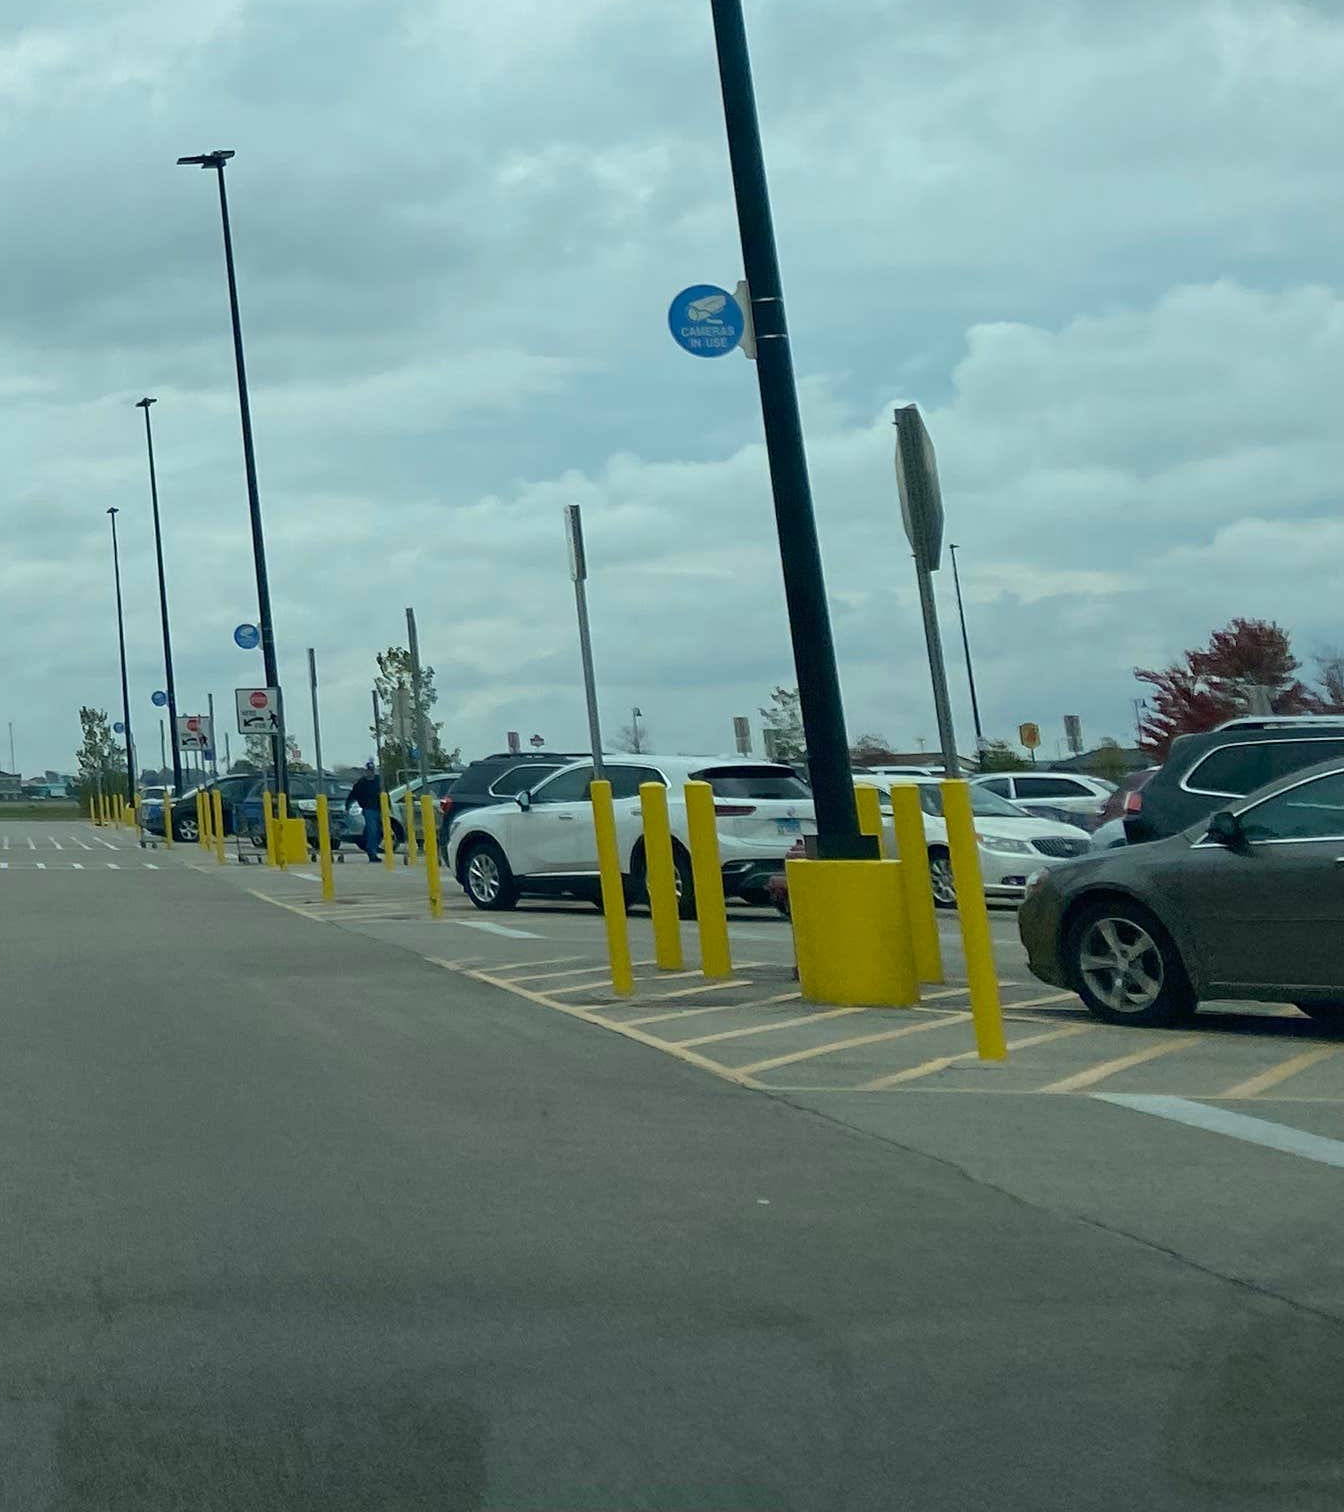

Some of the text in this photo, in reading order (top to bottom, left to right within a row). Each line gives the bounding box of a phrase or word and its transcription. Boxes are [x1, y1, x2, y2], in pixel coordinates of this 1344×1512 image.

[681, 326, 735, 337] CAMERAS
[690, 337, 728, 348] IN USE
